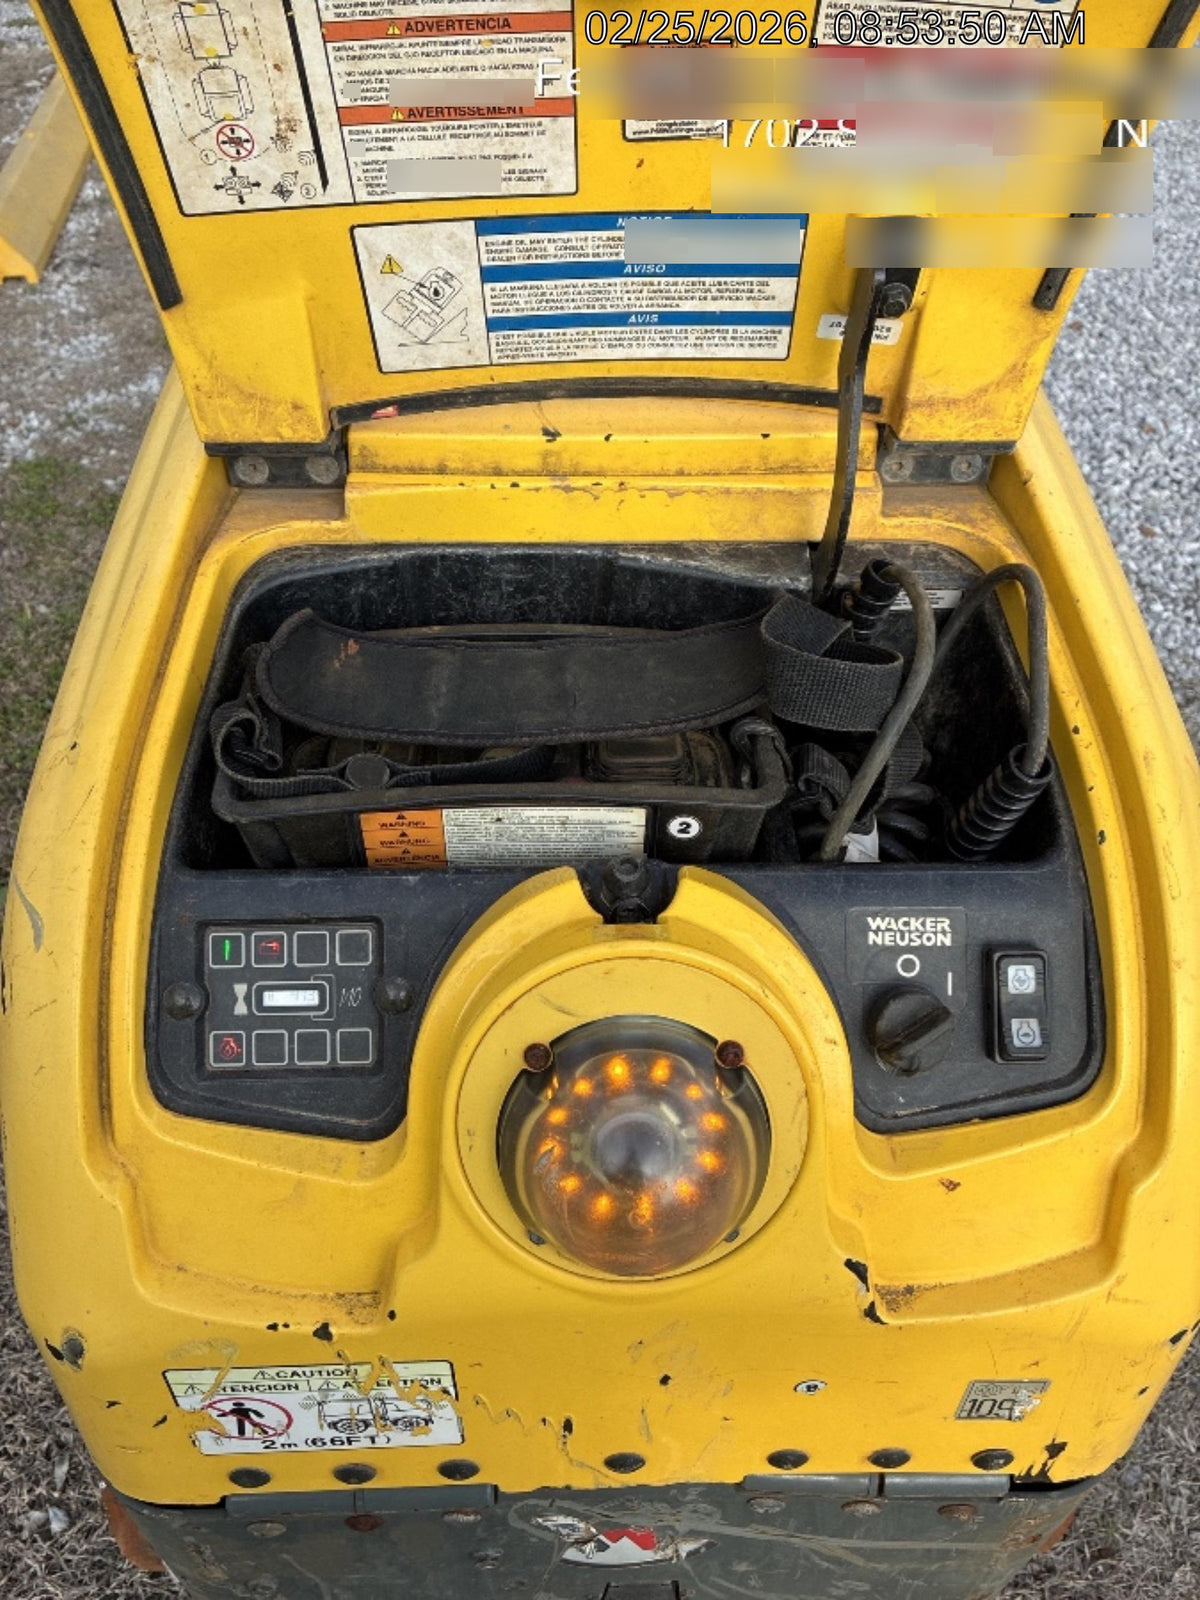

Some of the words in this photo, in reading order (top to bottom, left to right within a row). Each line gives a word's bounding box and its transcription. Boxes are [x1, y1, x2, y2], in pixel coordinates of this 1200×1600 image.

[404, 17, 511, 35] ADVERTENCIA
[623, 263, 666, 274] AVISO
[628, 315, 660, 325] AVIS
[676, 821, 693, 835] 2
[866, 916, 952, 932] WACKER
[867, 931, 952, 946] NEUSON
[274, 1368, 358, 1380] CAUTION
[210, 1382, 299, 1394] TENCION
[968, 1398, 1016, 1421] 109
